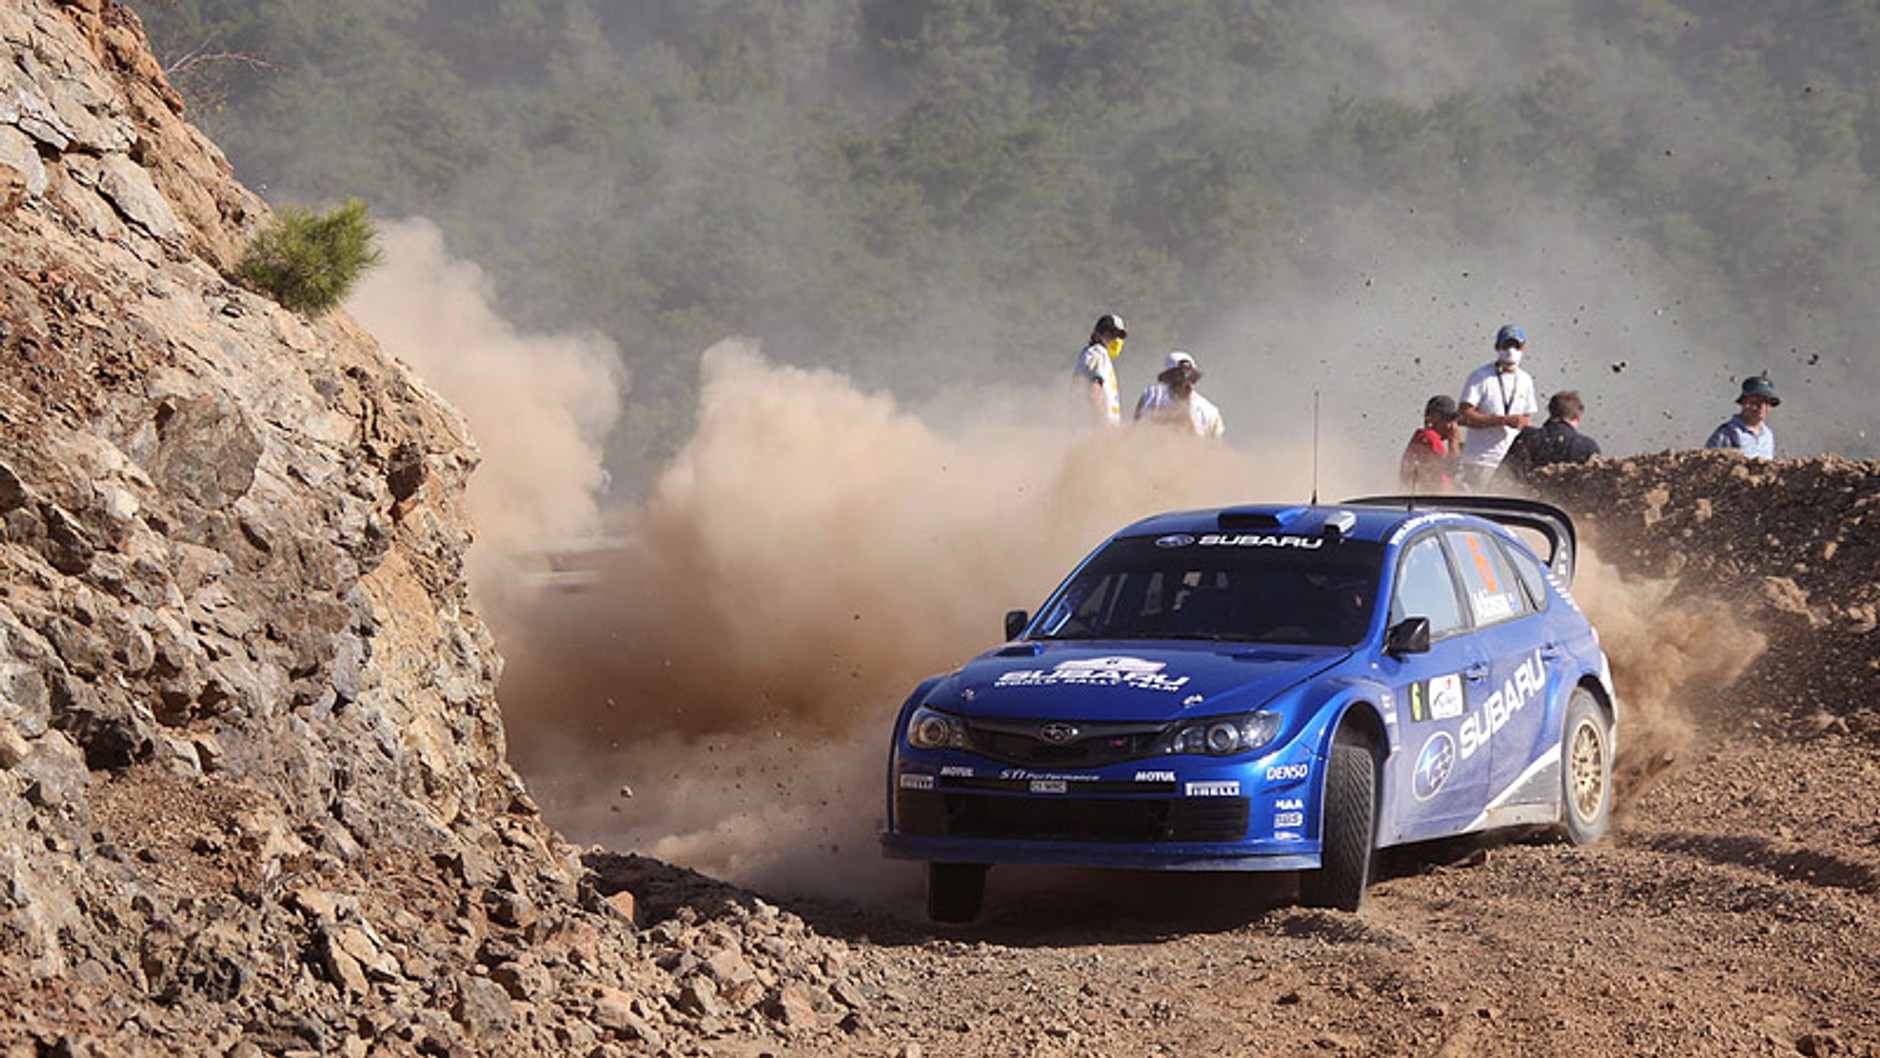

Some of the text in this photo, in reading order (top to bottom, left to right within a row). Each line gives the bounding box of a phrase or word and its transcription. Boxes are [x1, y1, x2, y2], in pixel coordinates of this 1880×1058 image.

[1198, 534, 1324, 549] SUBARU
[1466, 533, 1497, 595] 6
[994, 678, 1180, 692] WORLD RALLY TEAM
[998, 669, 1190, 686] SUBARU
[1459, 648, 1547, 761] SUBARU
[940, 766, 975, 778] MOTUL
[1134, 771, 1177, 782] MOTUL
[1265, 764, 1309, 781] DENSO
[1184, 781, 1240, 797] PIRELLI
